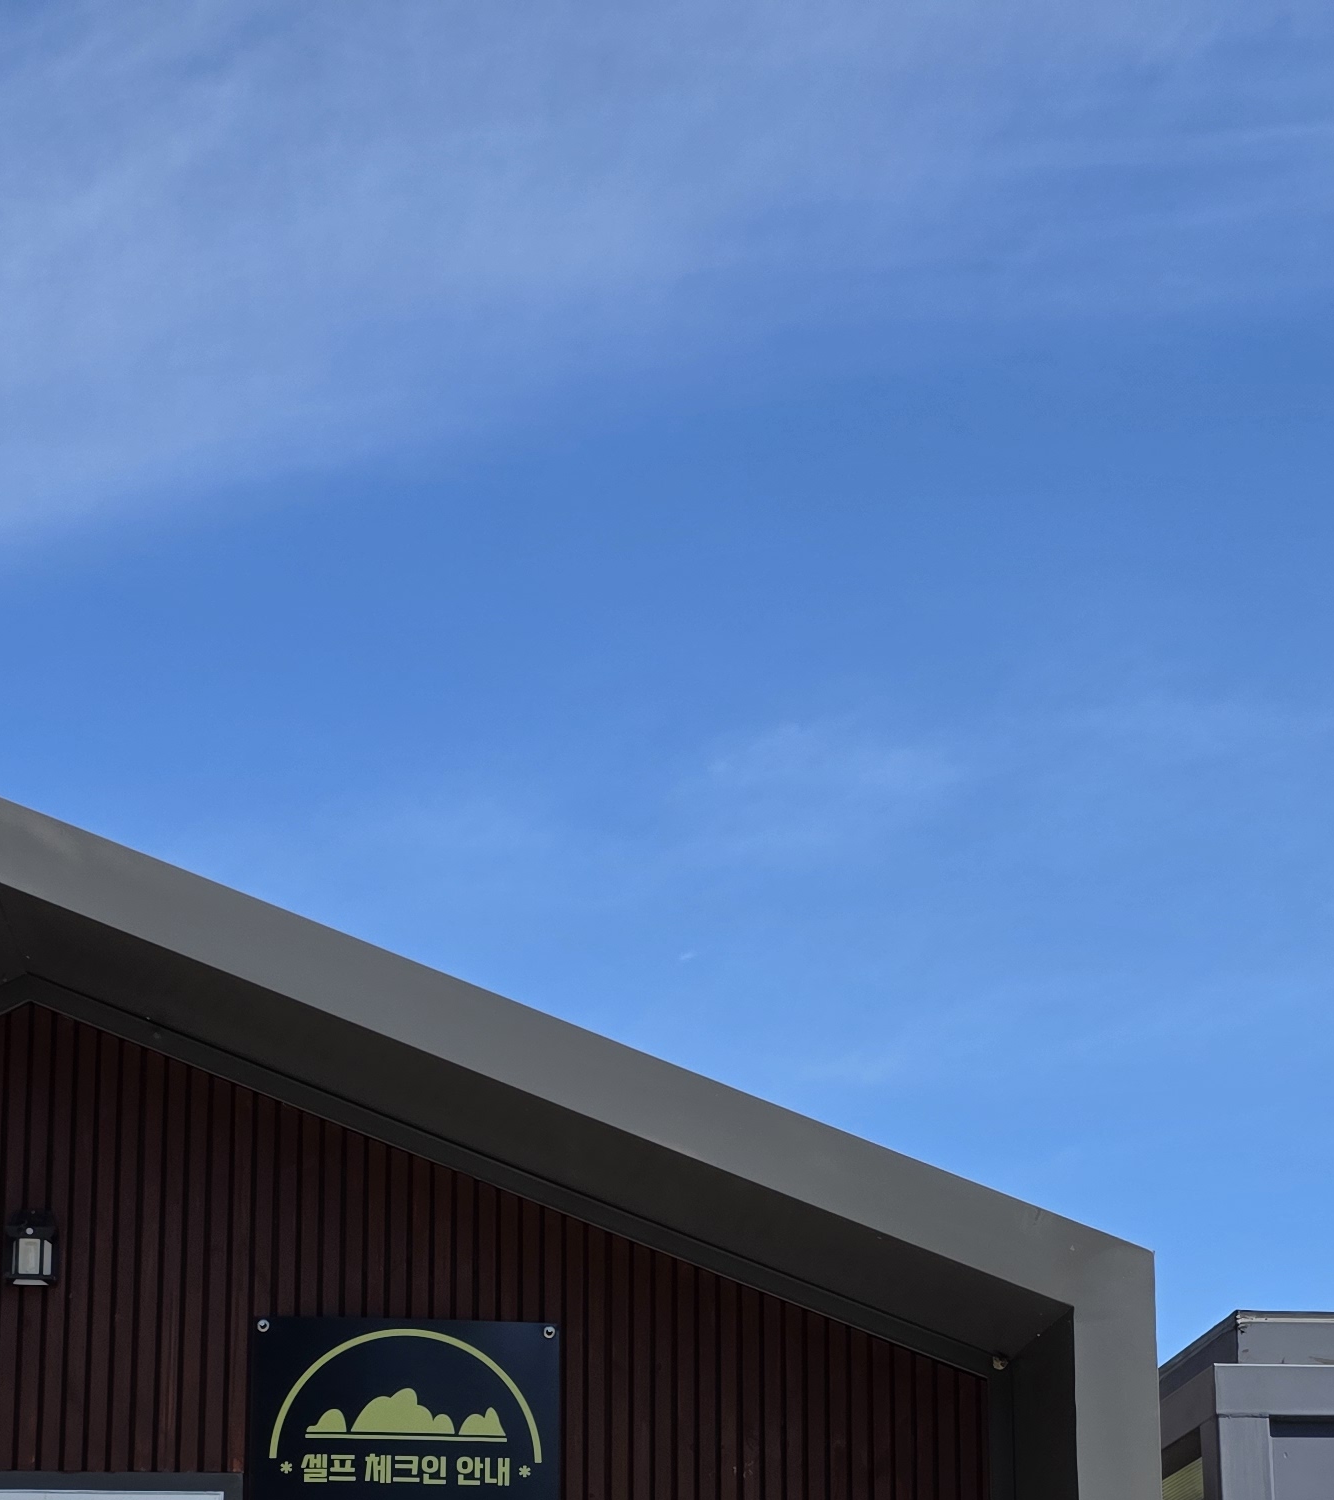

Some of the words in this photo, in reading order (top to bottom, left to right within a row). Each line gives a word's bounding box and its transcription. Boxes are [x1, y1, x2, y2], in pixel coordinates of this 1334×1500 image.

[300, 1453, 357, 1483] 셀프
[364, 1453, 447, 1485] 체크인
[456, 1456, 511, 1487] 안내
